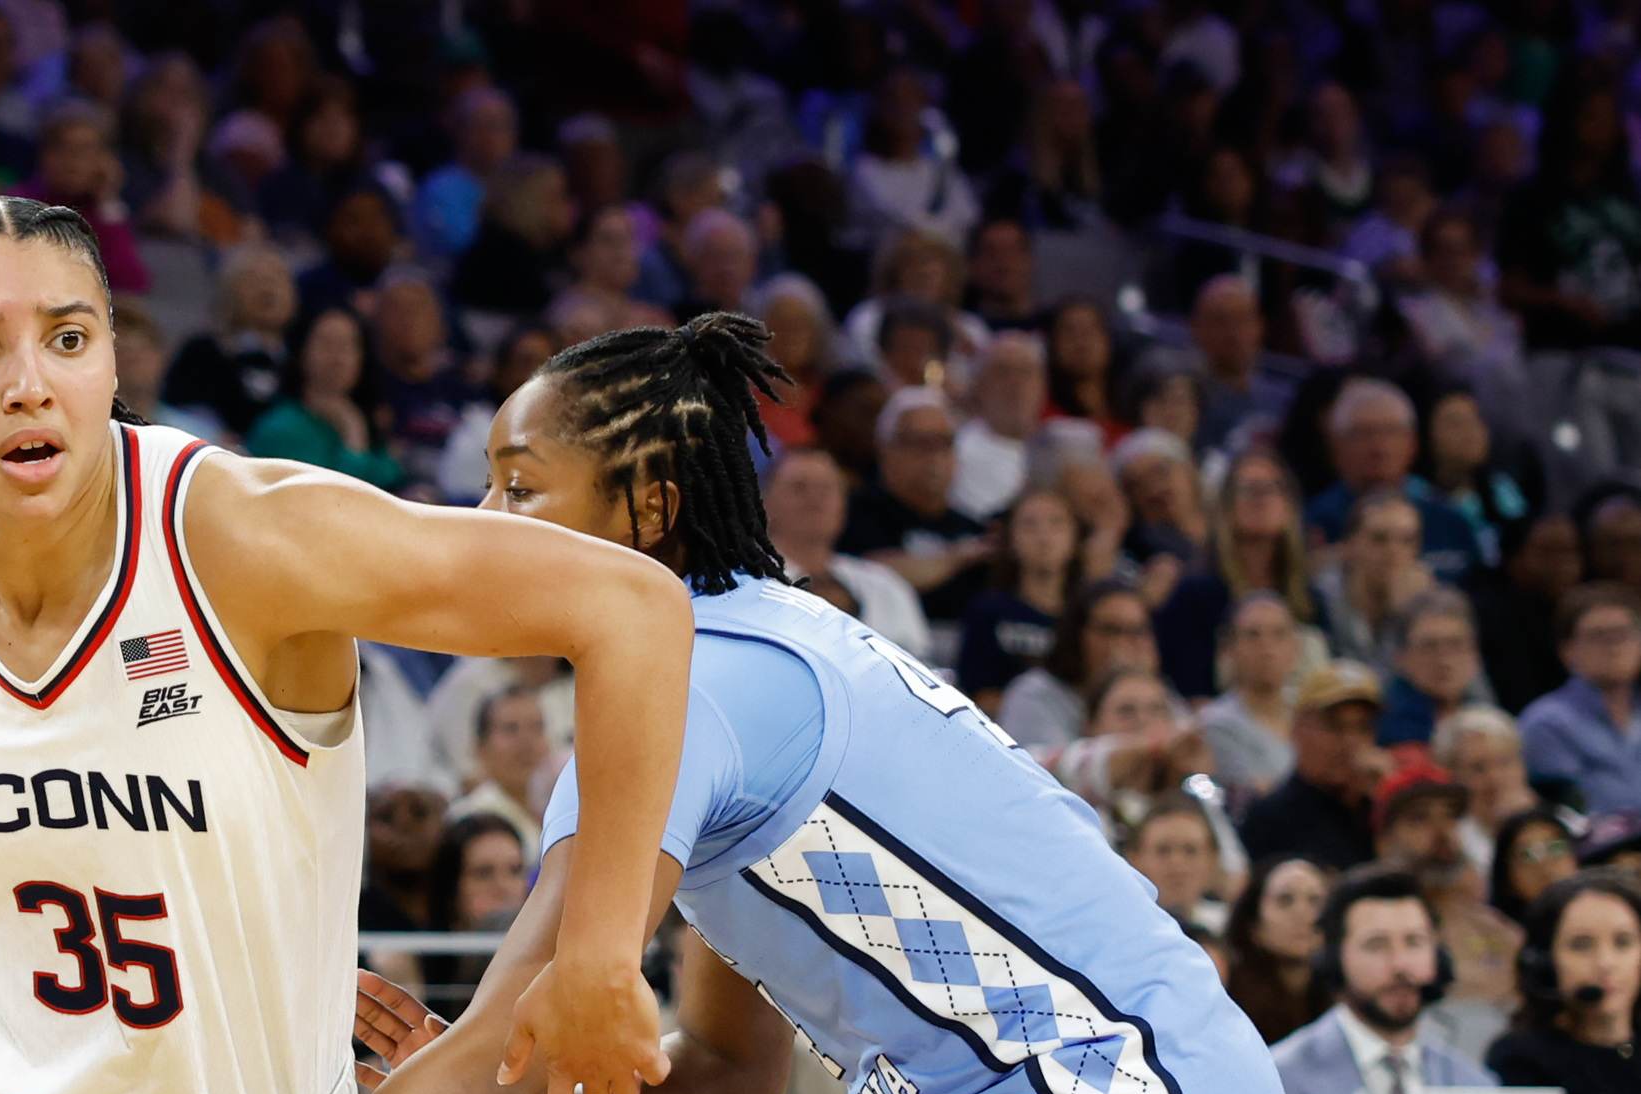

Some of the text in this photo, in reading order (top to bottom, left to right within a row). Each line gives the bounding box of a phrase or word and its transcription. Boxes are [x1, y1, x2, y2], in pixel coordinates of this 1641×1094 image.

[142, 682, 188, 705] BIG
[138, 695, 203, 720] EAST
[12, 879, 184, 1030] 35
